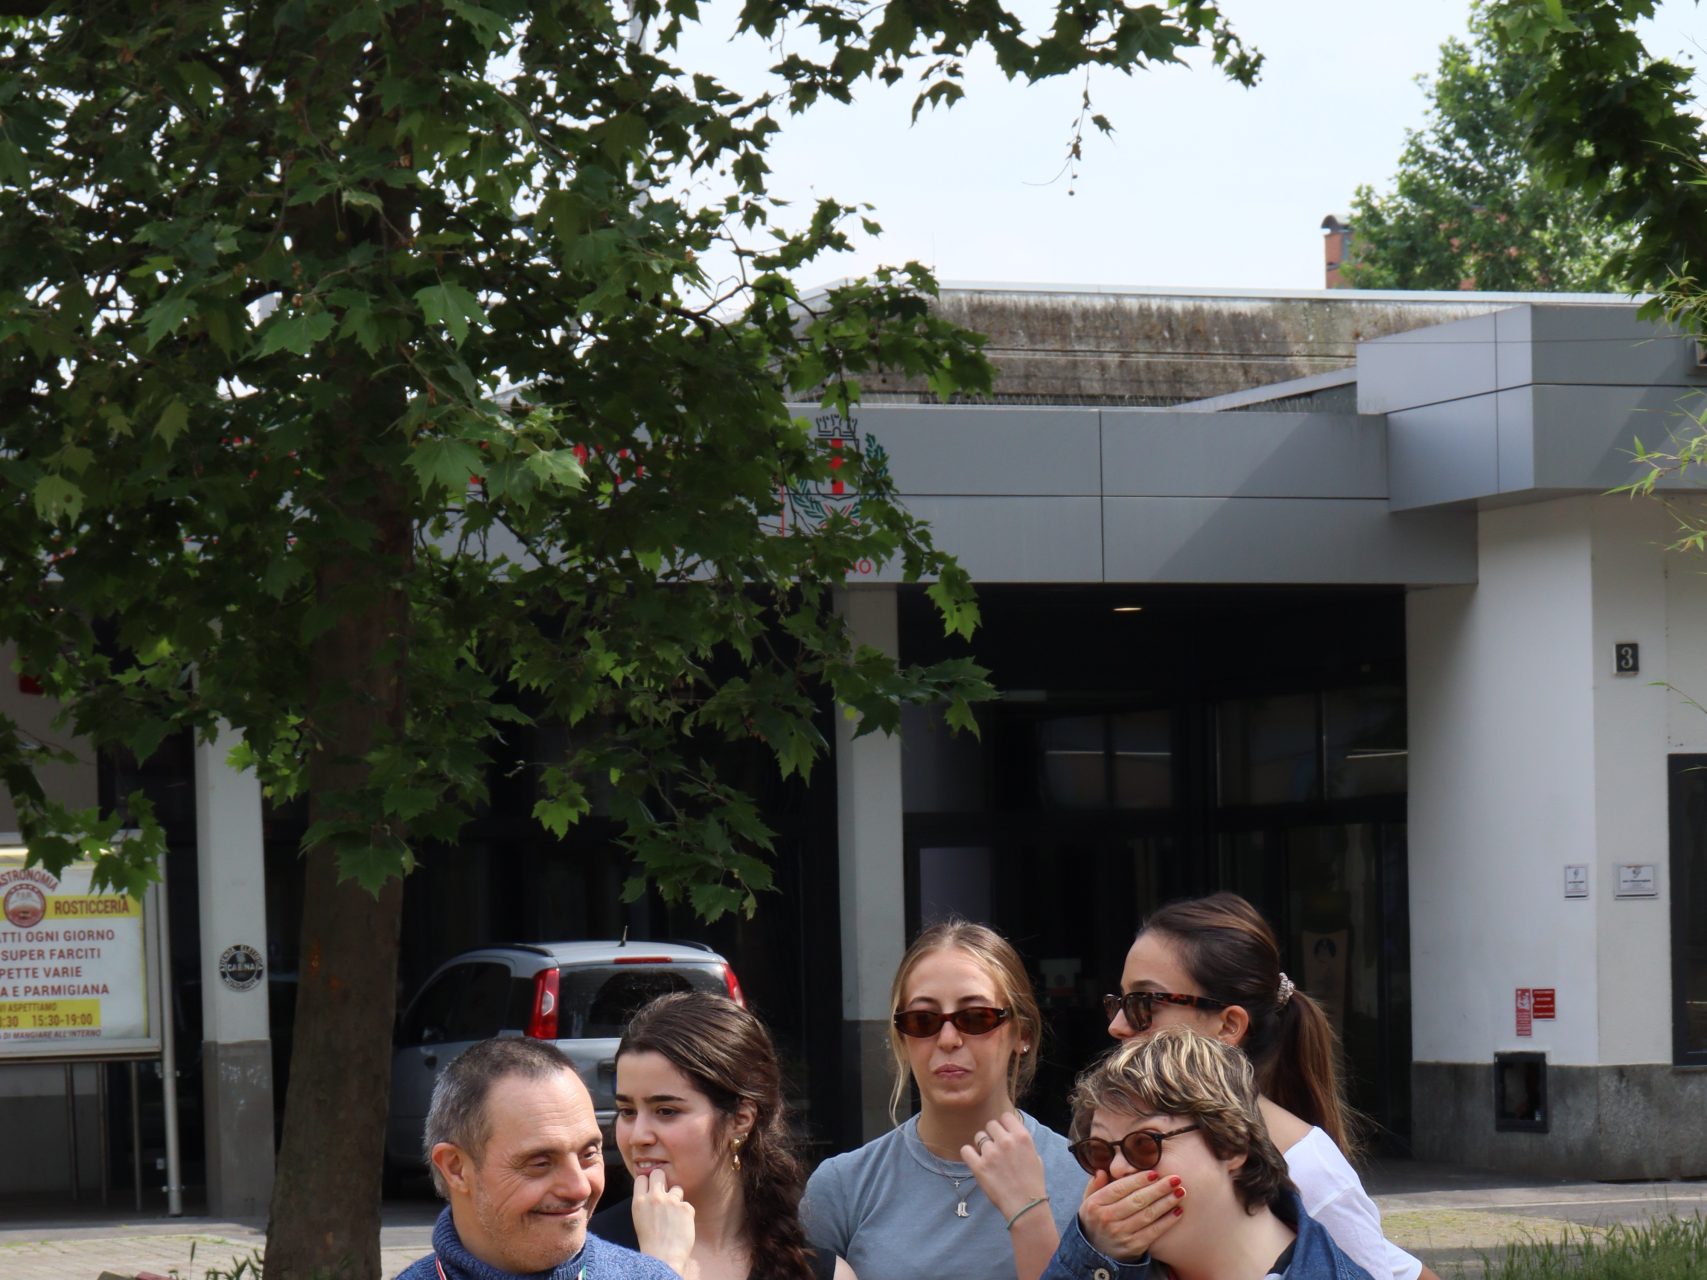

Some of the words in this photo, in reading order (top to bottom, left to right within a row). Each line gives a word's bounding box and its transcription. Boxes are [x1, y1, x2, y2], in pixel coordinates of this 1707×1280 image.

[1620, 646, 1633, 669] 3
[0, 869, 59, 892] STRONOMIA
[54, 899, 130, 916] ROSTICCERIA
[25, 931, 59, 943] OGNI
[63, 929, 115, 942] GIORNO
[1, 949, 45, 961] SUPER
[49, 948, 101, 960] FARCITI
[43, 966, 83, 978] VARIE
[12, 986, 19, 997] E
[24, 984, 110, 996] PARMIGIANA
[8, 1002, 57, 1012] ASPETTIAMO
[32, 1013, 93, 1027] 15:30-19:00
[13, 1030, 52, 1039] MANGIARE
